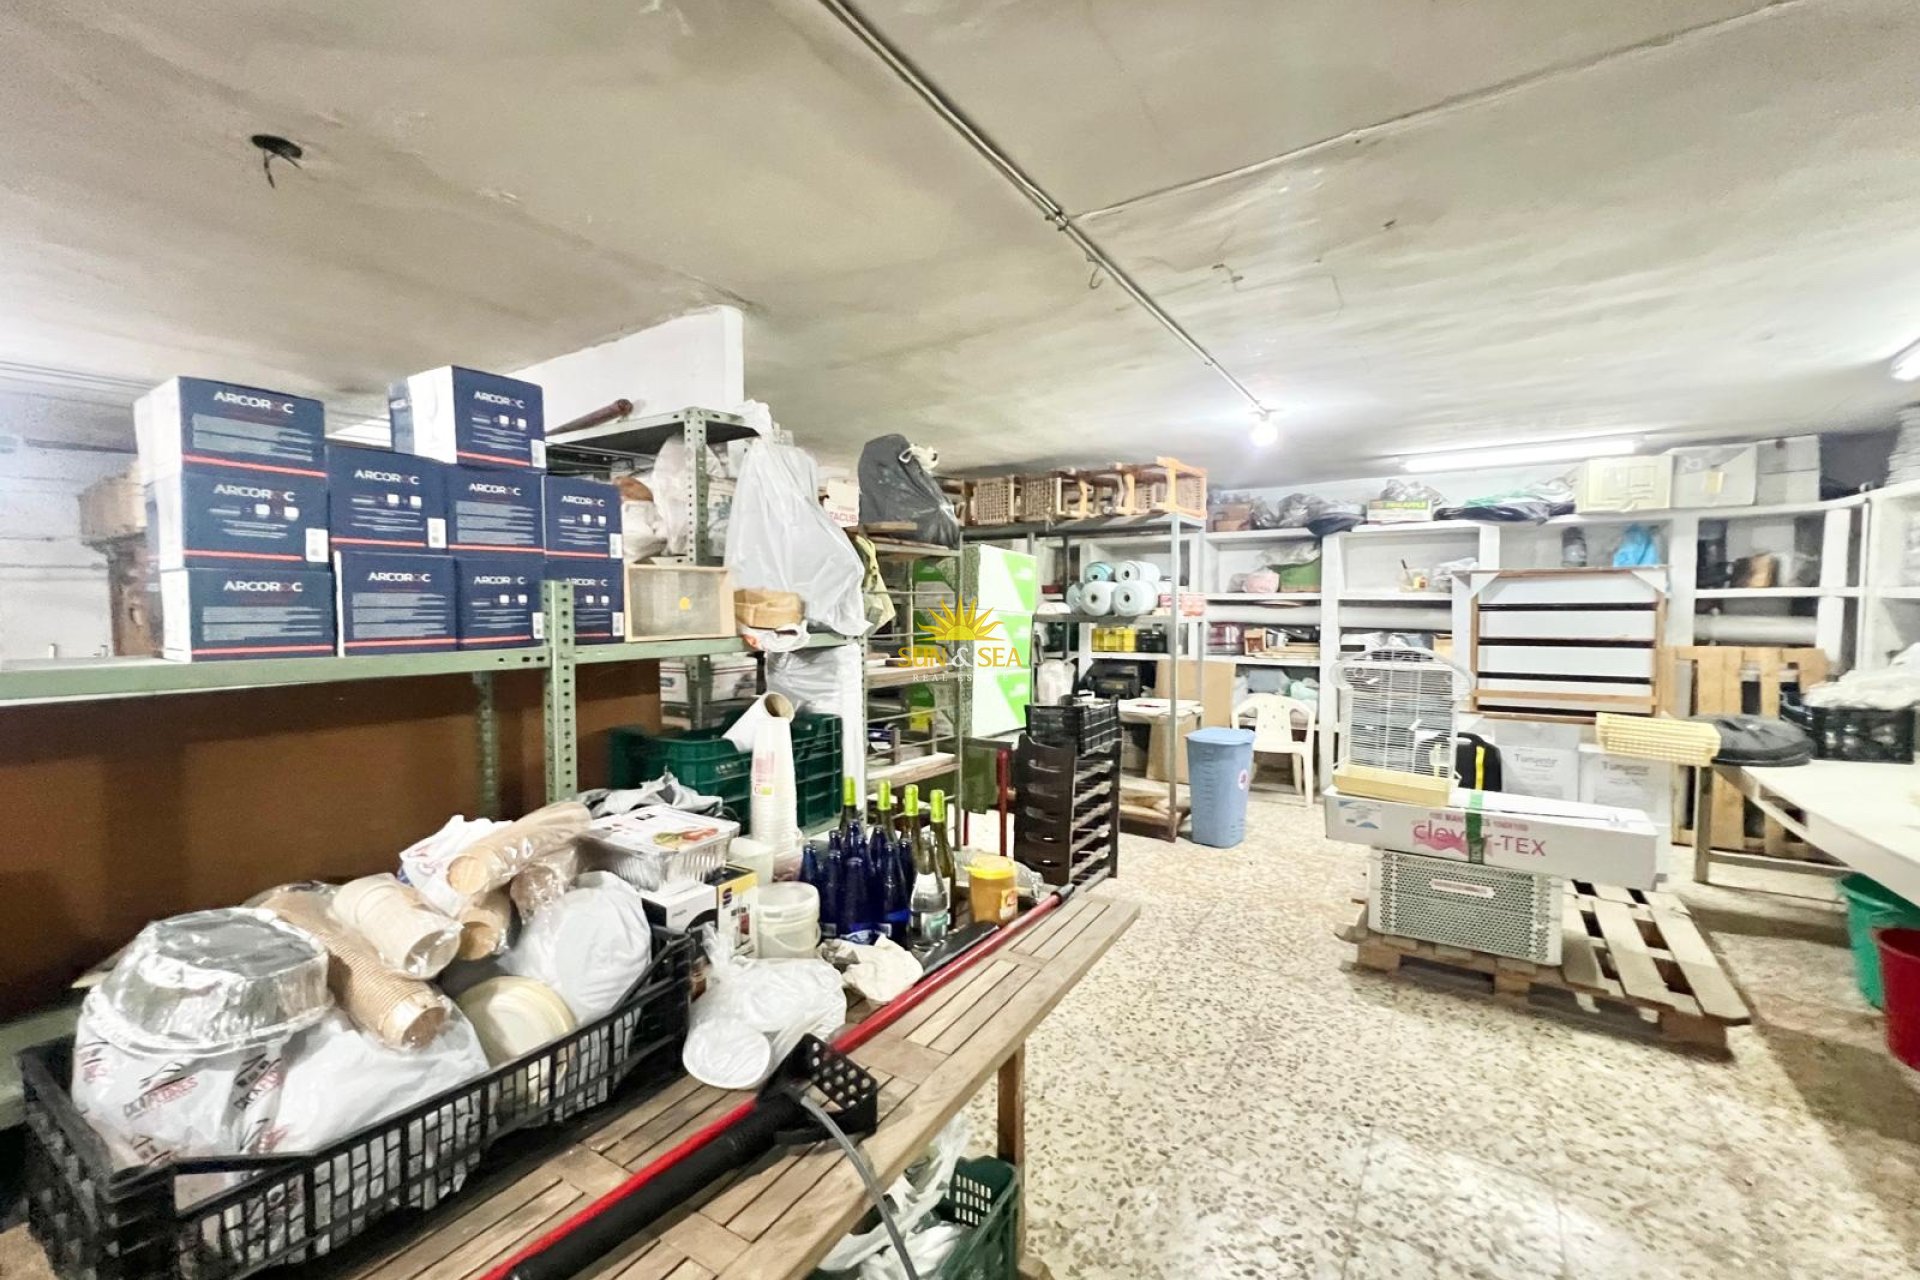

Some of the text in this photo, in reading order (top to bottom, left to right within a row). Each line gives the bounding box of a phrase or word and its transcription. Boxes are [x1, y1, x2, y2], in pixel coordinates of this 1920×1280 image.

[473, 576, 526, 586] ARCORC
[565, 577, 608, 587] ARCORC
[1413, 819, 1546, 857] clevr-TEX
